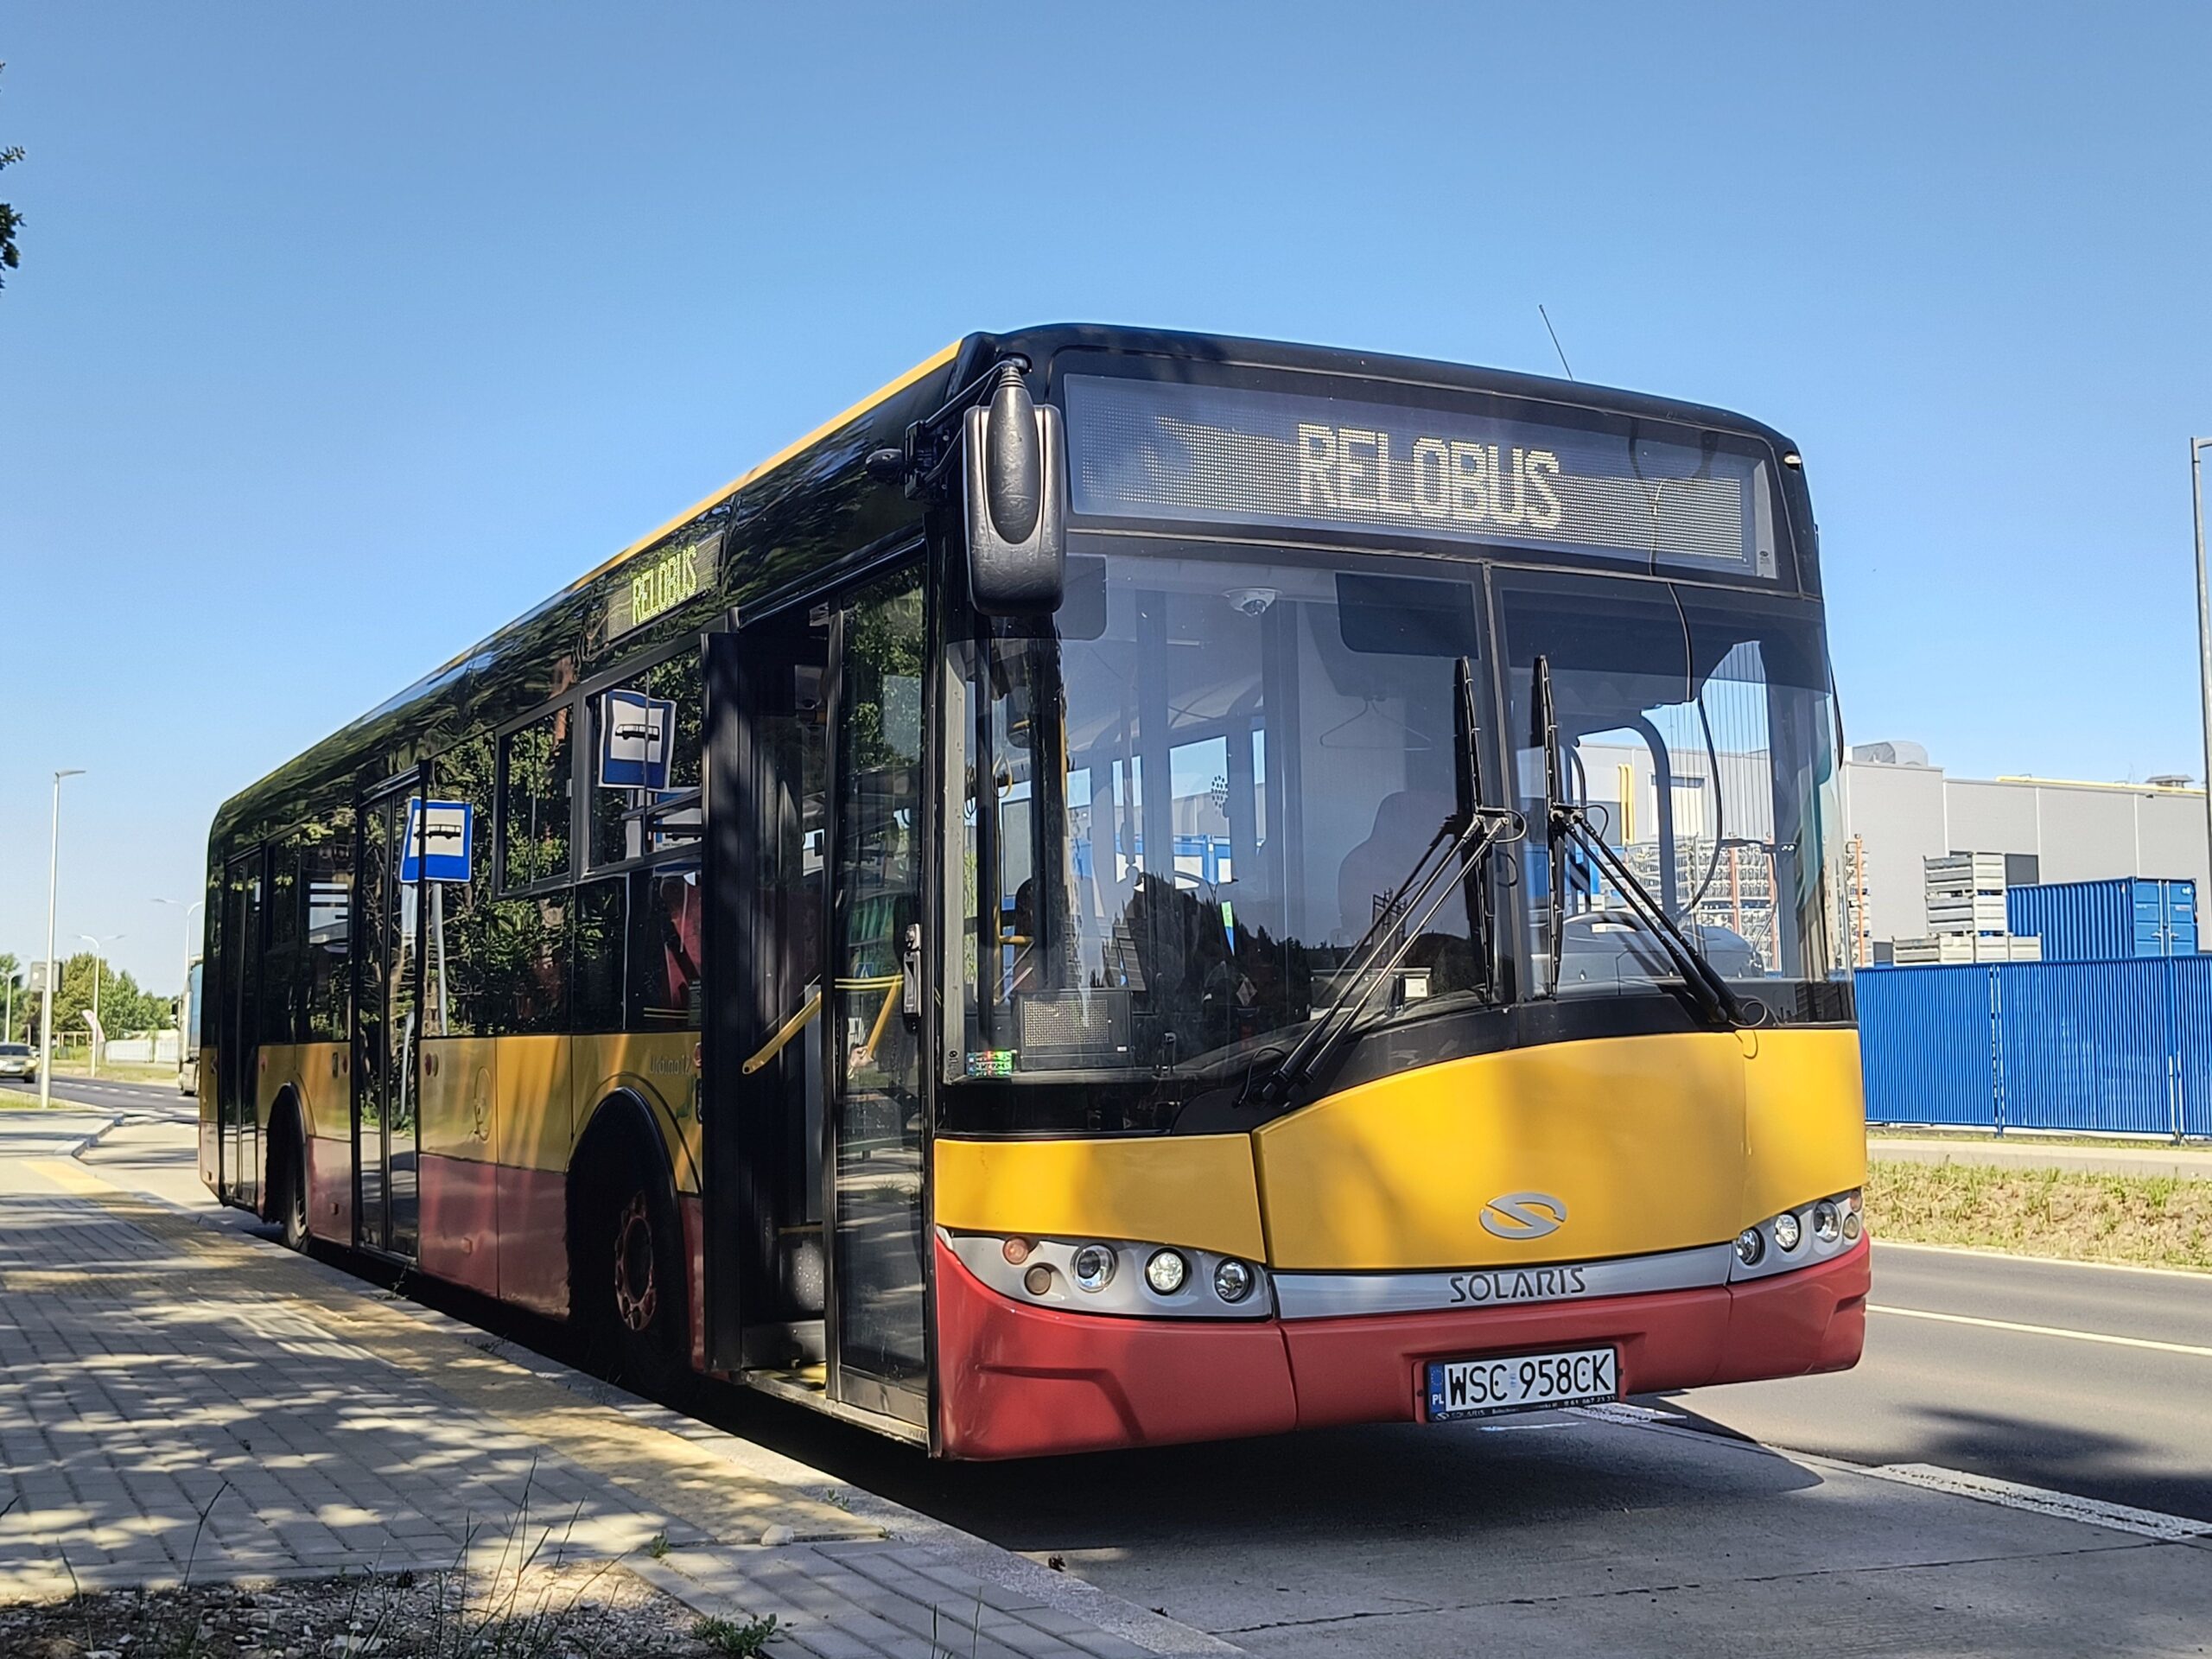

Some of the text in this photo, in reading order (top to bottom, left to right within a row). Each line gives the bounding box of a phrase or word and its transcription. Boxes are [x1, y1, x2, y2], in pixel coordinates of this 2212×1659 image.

[1297, 423, 1562, 530] RELOBUS
[632, 545, 697, 626] RELOBUS
[1450, 1268, 1586, 1303] SOLARIS
[1432, 1394, 1444, 1405] PL
[1448, 1353, 1611, 1406] WSC 958CK
